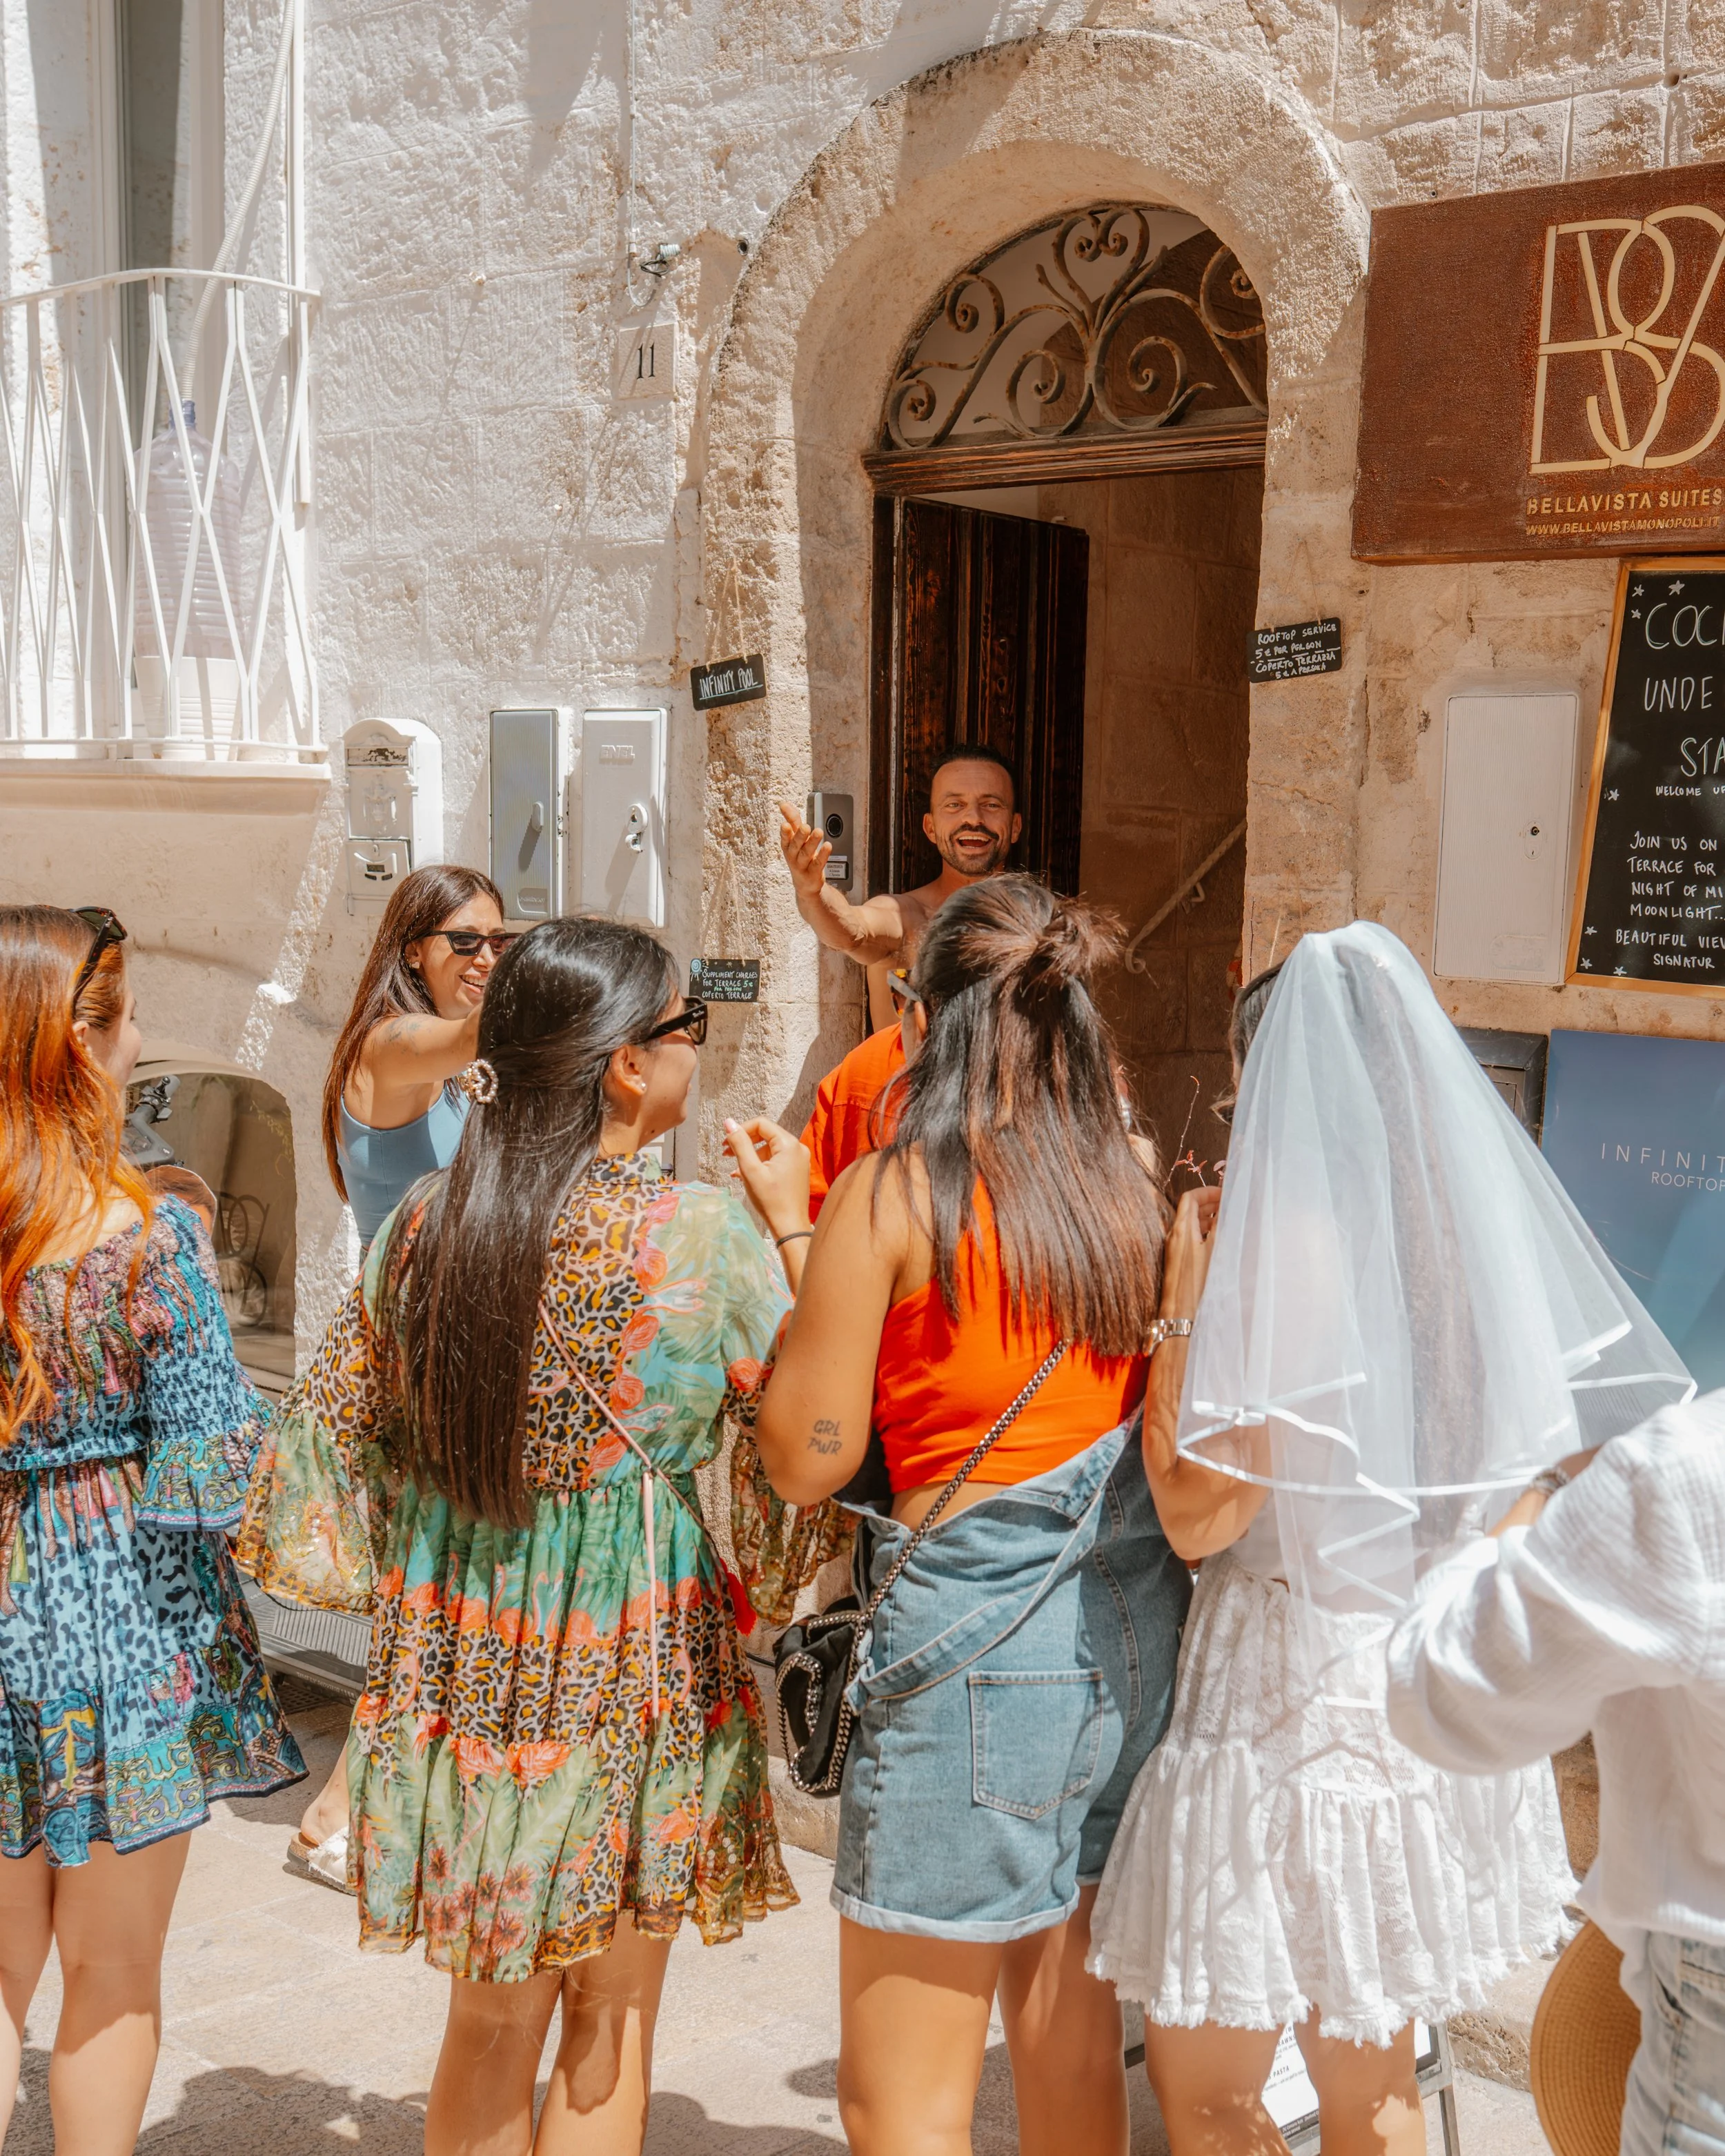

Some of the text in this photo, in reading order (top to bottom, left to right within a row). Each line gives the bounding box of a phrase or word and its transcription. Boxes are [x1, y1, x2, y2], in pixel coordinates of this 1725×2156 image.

[636, 342, 656, 379] 11
[1526, 488, 1723, 515] BELLAVISTA SUITES
[1645, 602, 1725, 650] COC
[1257, 629, 1297, 645] ROOFTOP
[1274, 646, 1288, 655] PER
[1255, 651, 1336, 673] COPERTO TERRAZZA
[700, 667, 758, 698] INFINITY POOL
[1644, 676, 1713, 713] UNDE
[1656, 786, 1702, 796] WELCOME
[1630, 831, 1717, 851] JOIN US ON
[1626, 856, 1717, 877] TERRACE FOR
[1631, 881, 1675, 896] NIGHT
[1684, 884, 1697, 897] OF
[1616, 929, 1687, 947] BEAUTIFUL
[1653, 953, 1715, 969] SIGNATUR
[702, 978, 713, 987] FOR
[702, 991, 754, 1000] COPERTO TERRACE
[814, 1419, 840, 1436] GRL
[1273, 2065, 1290, 2078] PASTA
